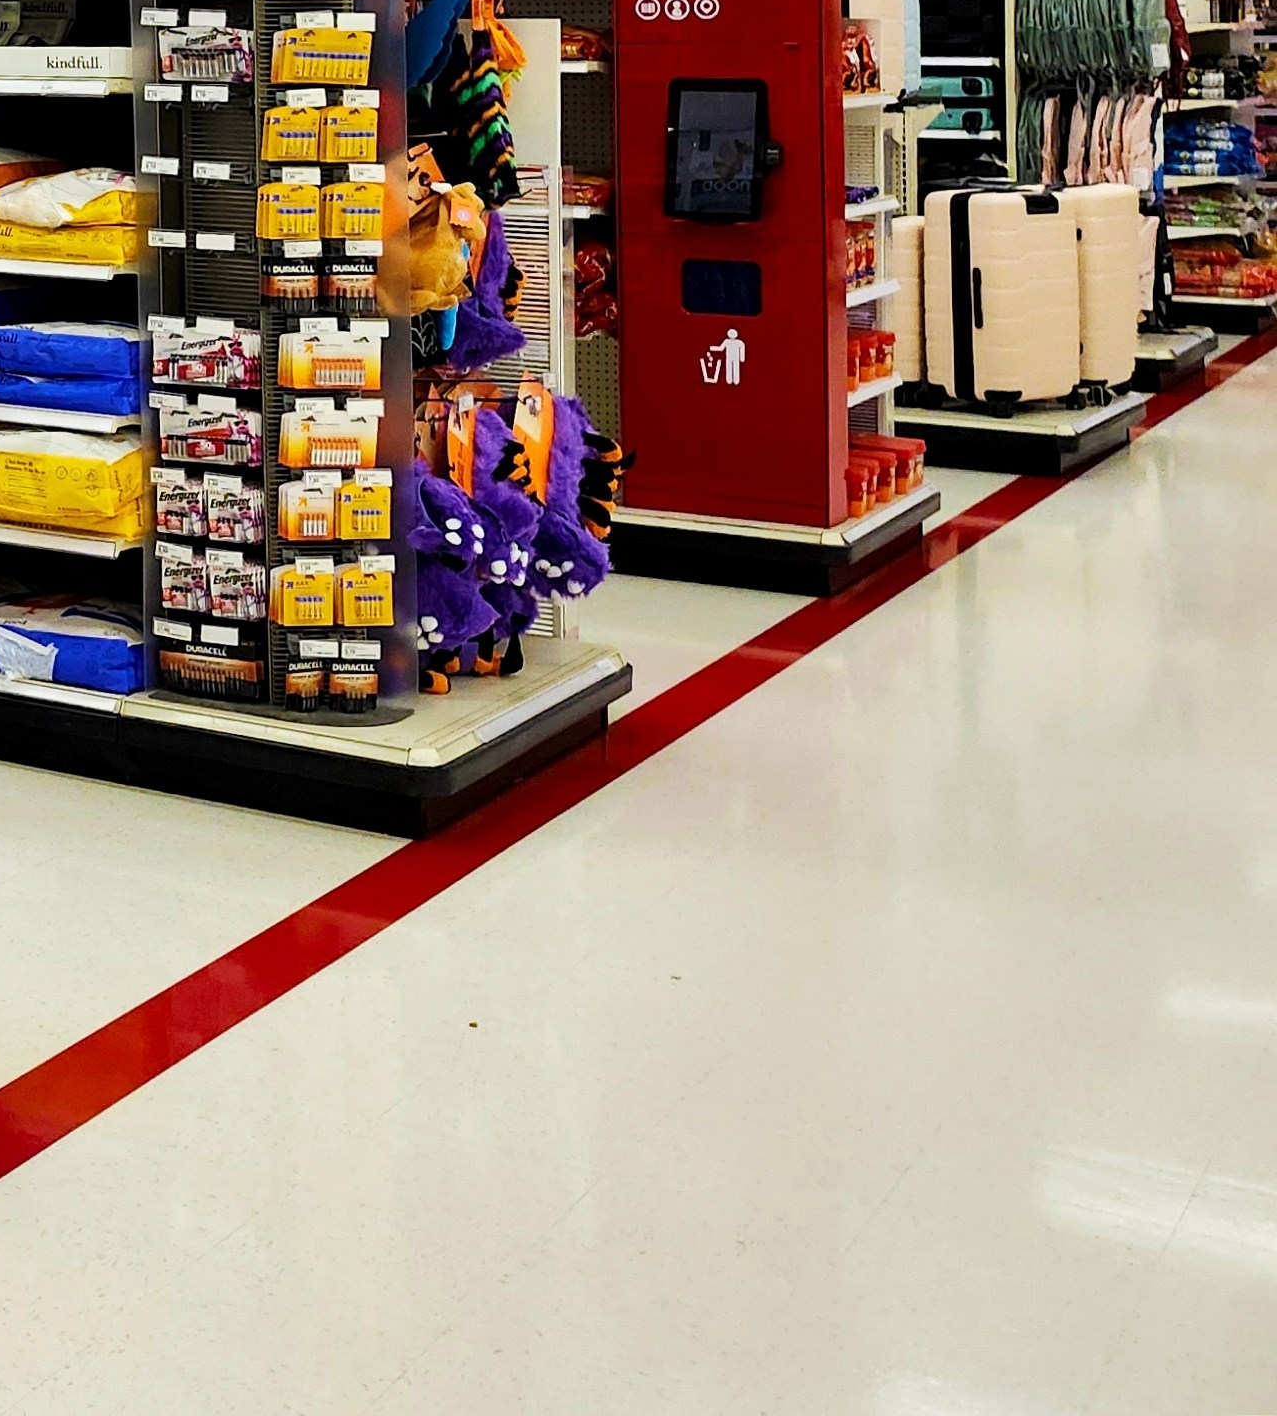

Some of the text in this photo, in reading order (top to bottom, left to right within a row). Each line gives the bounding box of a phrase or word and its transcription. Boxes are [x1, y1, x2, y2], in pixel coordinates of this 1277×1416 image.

[46, 55, 103, 70] kindfull.
[273, 265, 315, 274] DURACELL
[333, 264, 375, 273] DURACELL
[181, 338, 218, 351] Energizer
[188, 416, 223, 428] Energizer
[159, 491, 199, 503] Energizer
[210, 497, 251, 509] Energizer
[164, 567, 204, 579] Energizer
[213, 573, 253, 586] Energizer
[186, 645, 227, 656] DURACELL
[289, 661, 323, 671] DURACELL
[332, 663, 375, 672] DURACELL
